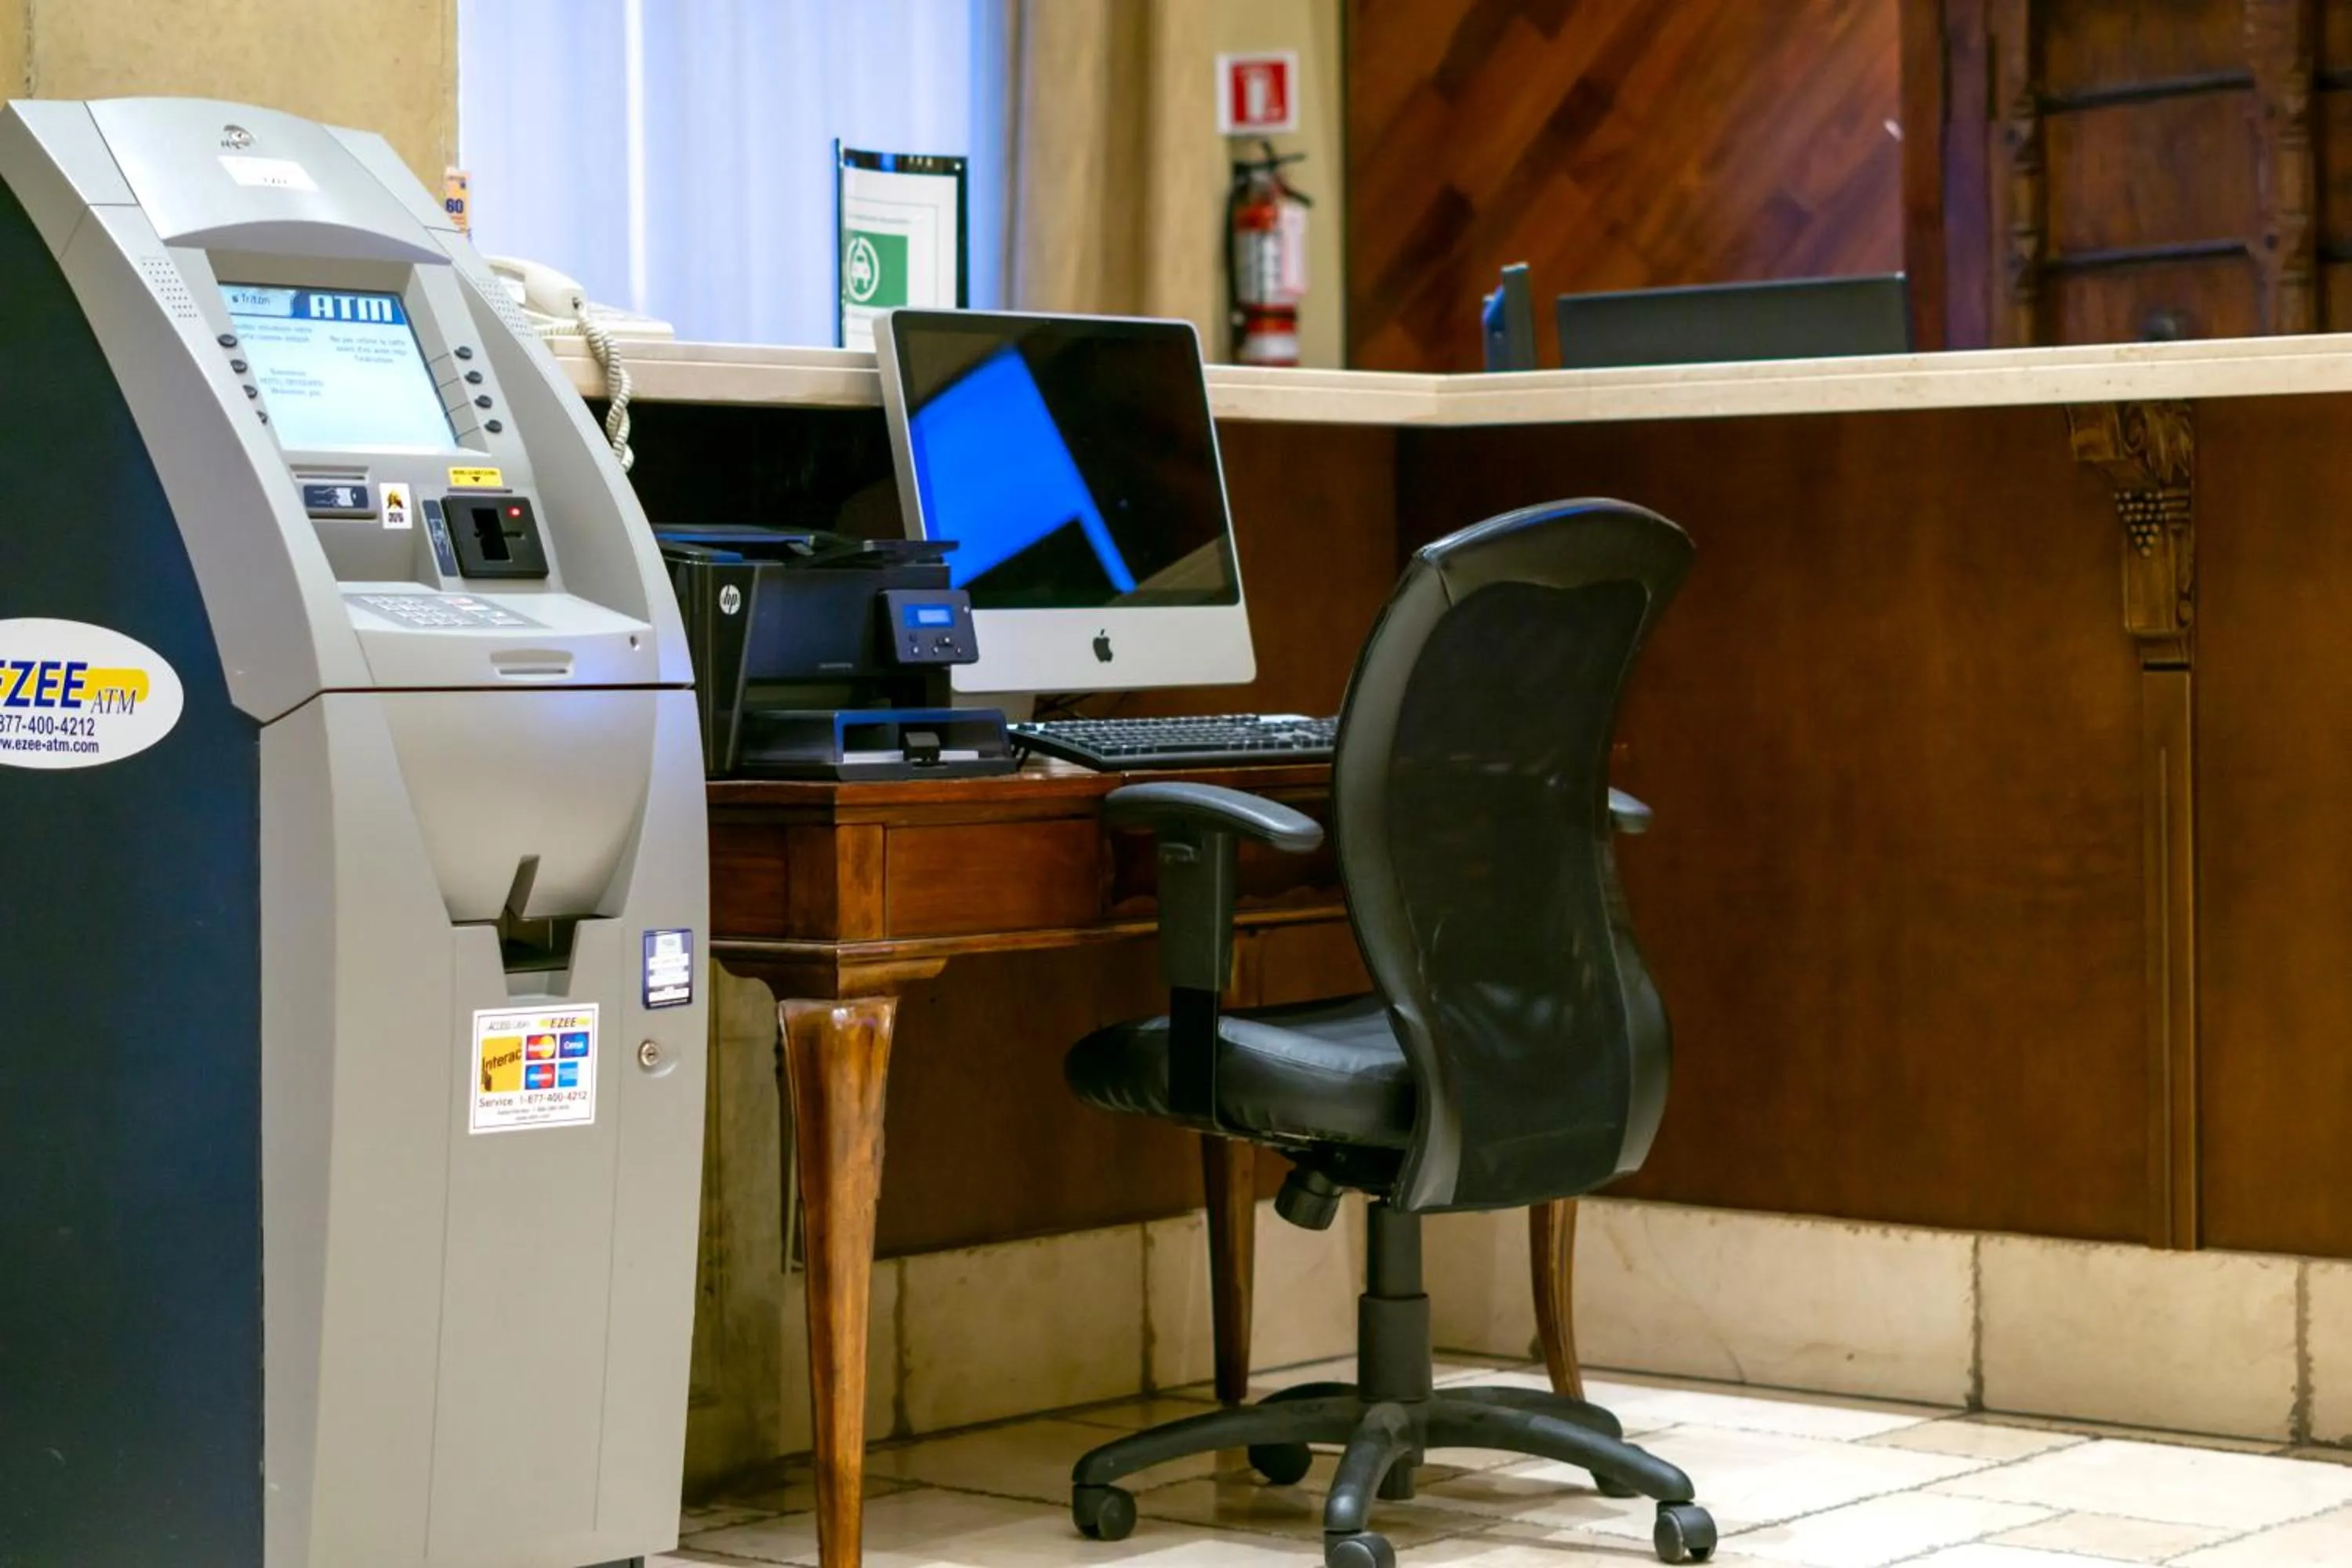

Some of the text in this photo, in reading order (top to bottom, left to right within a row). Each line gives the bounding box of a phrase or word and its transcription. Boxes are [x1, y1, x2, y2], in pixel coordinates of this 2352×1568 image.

[310, 294, 392, 322] ATM
[720, 584, 740, 615] hp
[0, 660, 137, 715] ZEE ATM
[550, 1017, 577, 1029] EZEE
[481, 1048, 522, 1071] Interac
[479, 1097, 514, 1108] Service
